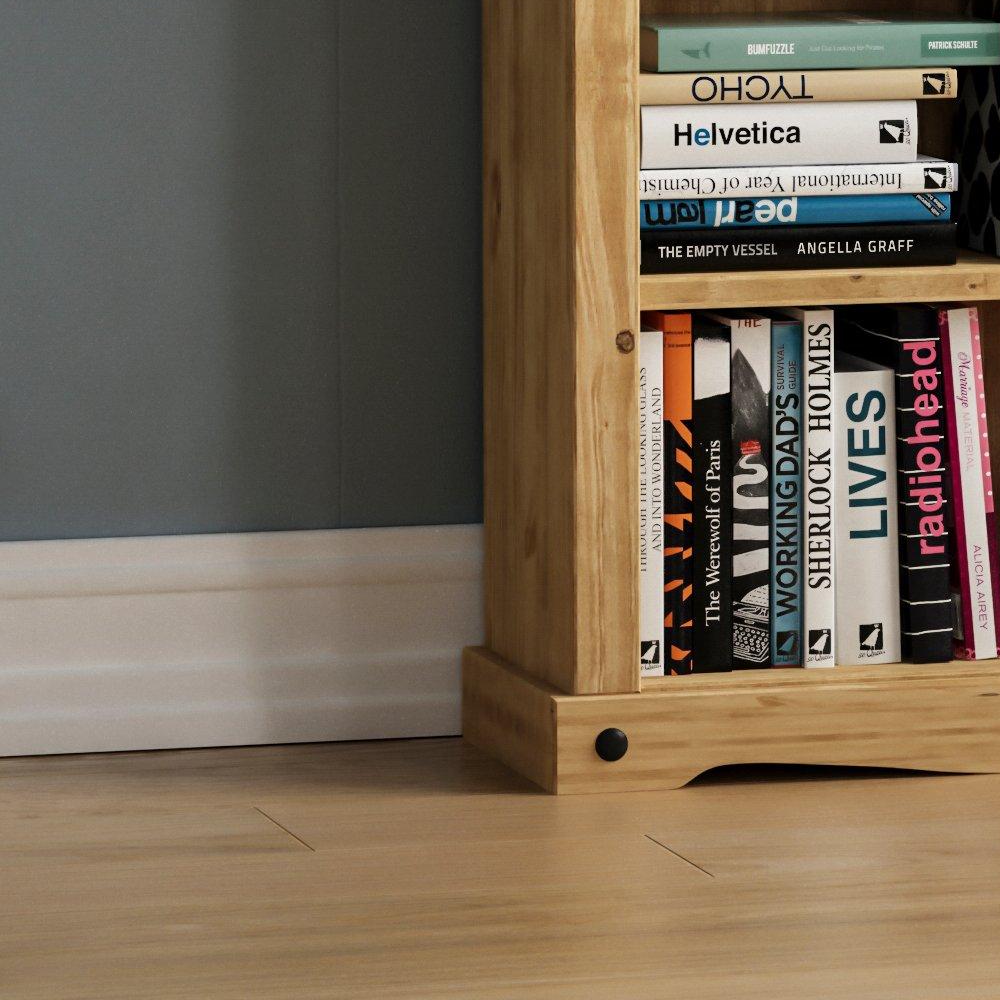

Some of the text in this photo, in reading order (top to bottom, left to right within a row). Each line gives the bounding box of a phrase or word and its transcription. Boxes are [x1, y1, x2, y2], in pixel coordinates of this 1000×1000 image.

[747, 43, 795, 55] BUMFUZZLE
[928, 40, 978, 50] PATRICK SCHULTE
[691, 75, 814, 102] TYCHO
[674, 121, 801, 146] Helvetica
[640, 173, 903, 196] International Year of Chemist
[713, 197, 798, 228] pearl
[658, 240, 914, 258] THE EMPTY VESSEL ANGELLA GRAFF
[777, 344, 785, 390] SURVIVAL
[788, 360, 797, 390] GUIDE
[956, 351, 975, 471] Marriage MATERIAL
[651, 387, 662, 552] AND INTO WONDERLAND
[808, 323, 832, 589] SHERLOCK HOLMES
[845, 389, 888, 539] LIVES
[903, 340, 946, 555] radiohead
[775, 393, 799, 617] WORKING DAD'S
[705, 440, 721, 627] The Werewolf of Paris
[972, 544, 989, 631] ALICIA AIREY
